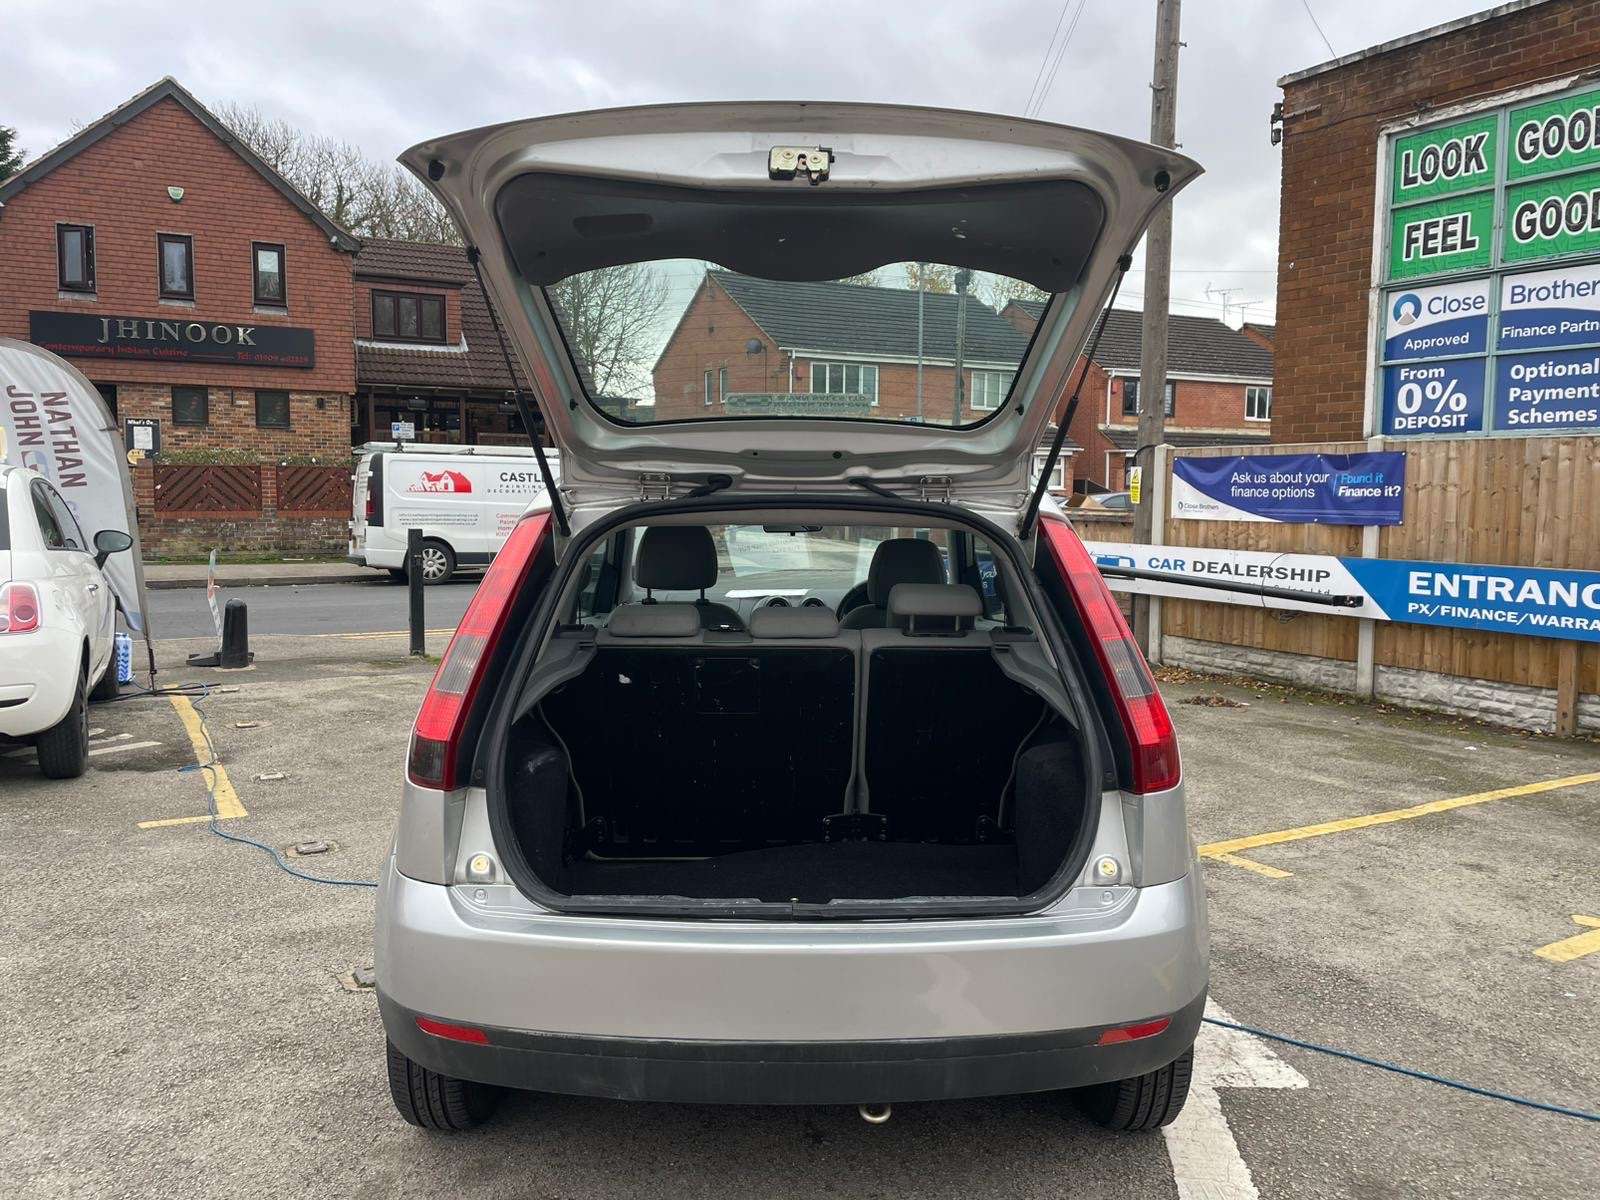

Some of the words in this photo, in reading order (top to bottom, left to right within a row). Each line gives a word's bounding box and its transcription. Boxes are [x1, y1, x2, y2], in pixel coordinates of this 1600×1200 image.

[1402, 132, 1488, 188] LOOK
[1517, 109, 1600, 163] GOO
[1403, 213, 1479, 261] FEEL
[1428, 295, 1485, 315] Close
[97, 318, 257, 346] JHINOOK
[1404, 332, 1469, 351] Approved
[1502, 325, 1556, 338] Finance
[1560, 320, 1600, 333] Partn
[1400, 367, 1445, 380] From
[1510, 358, 1600, 382] Optional
[1397, 380, 1467, 415] 0%
[1509, 383, 1600, 405] Payment
[6, 384, 45, 446] JOHN
[1394, 413, 1468, 430] DEPOSIT
[1508, 408, 1597, 424] Schemes
[40, 391, 88, 488] NATHAN
[1231, 472, 1251, 483] Ask
[1254, 474, 1267, 483] us
[1270, 472, 1302, 483] about
[1306, 474, 1329, 486] your
[1341, 473, 1373, 484] Found
[1375, 474, 1383, 483] it
[1231, 486, 1270, 497] finance
[1272, 486, 1315, 500] options
[1338, 486, 1381, 497] Finance
[1385, 485, 1401, 497] it?
[1148, 557, 1185, 571] CAR
[1192, 560, 1331, 583] DEALERSHIP
